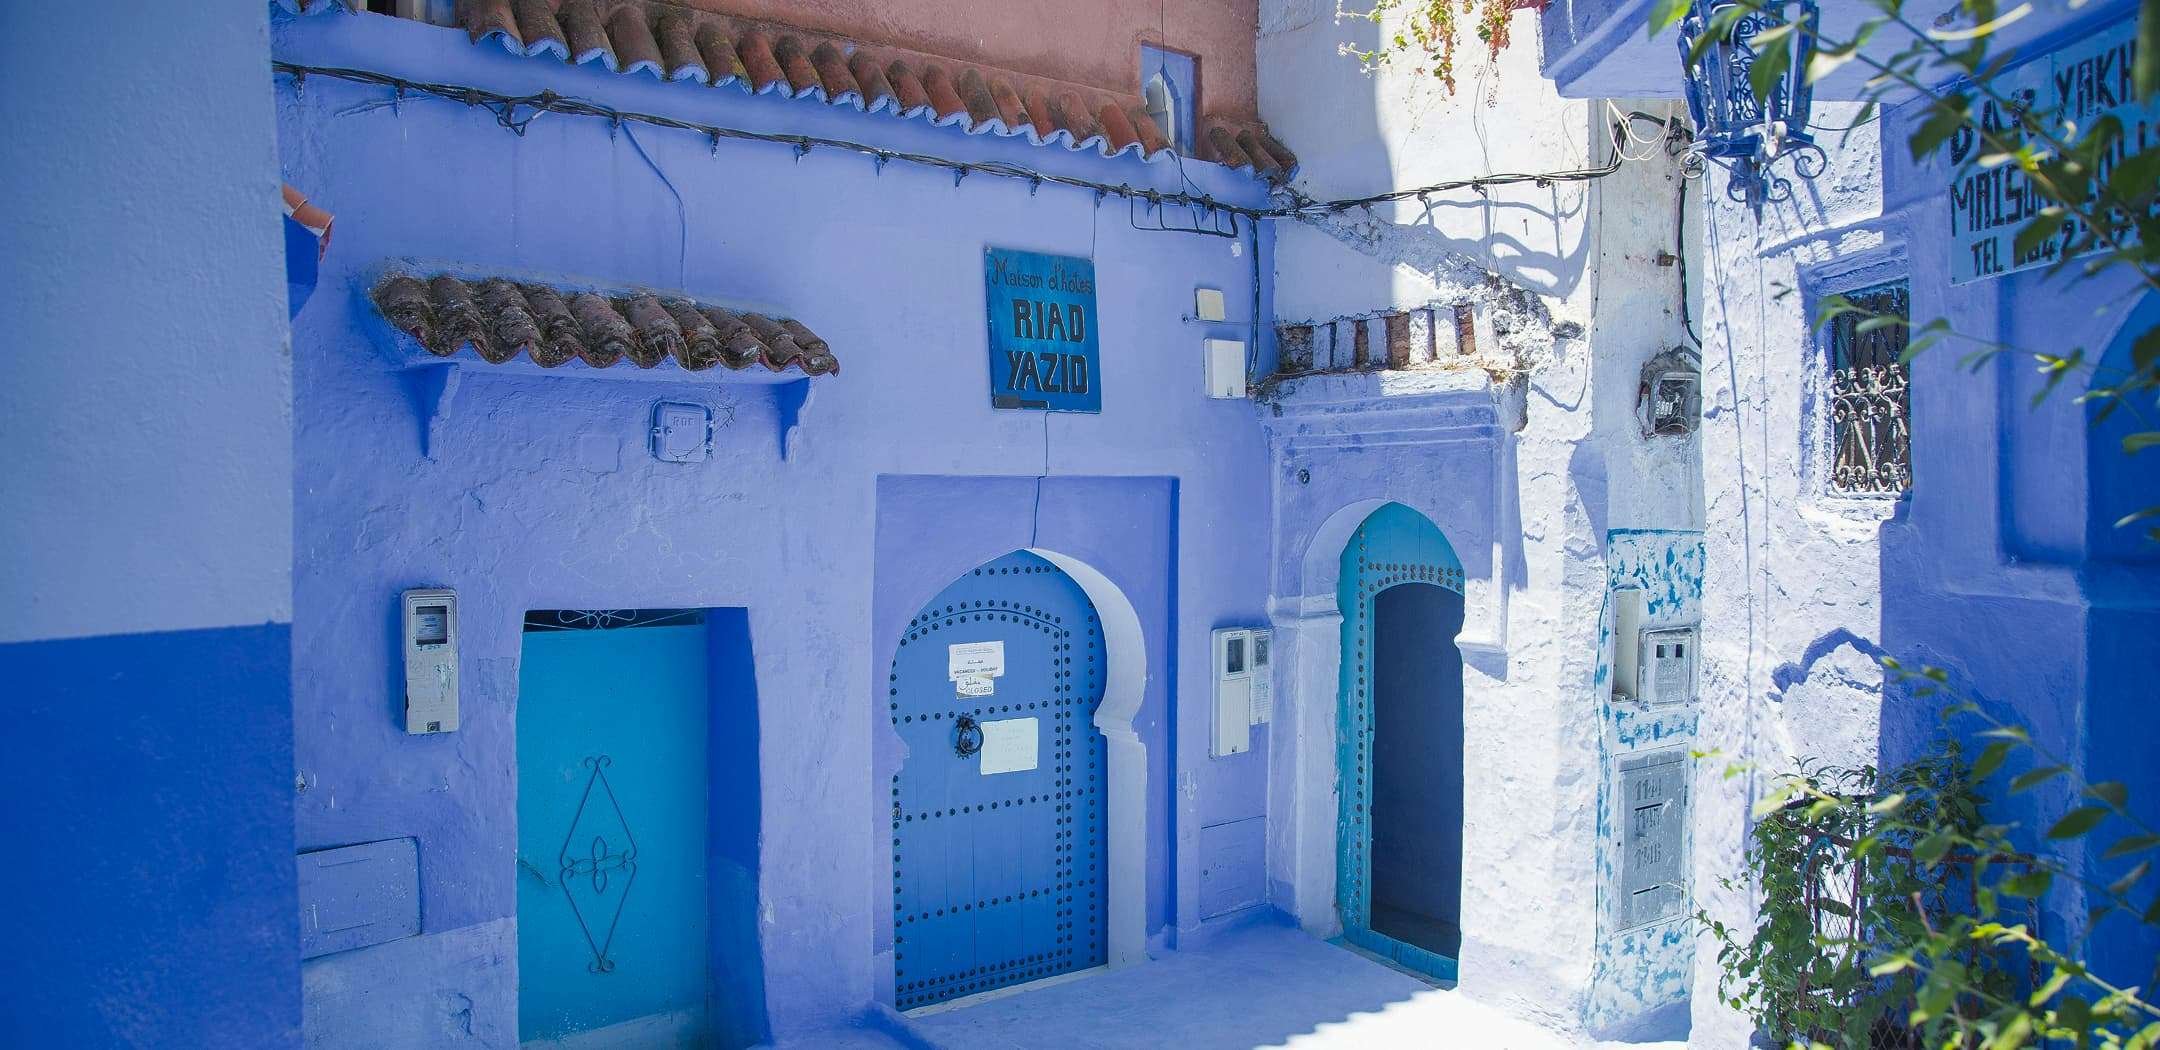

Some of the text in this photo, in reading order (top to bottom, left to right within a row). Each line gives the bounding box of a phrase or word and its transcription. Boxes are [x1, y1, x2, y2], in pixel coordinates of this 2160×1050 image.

[1950, 157, 2058, 238] MAISO
[992, 257, 1044, 289] Maison
[1971, 236, 2004, 277] TEL
[1012, 299, 1085, 343] RIAD
[1006, 350, 1088, 395] YAZID
[965, 686, 993, 694] CLOSED
